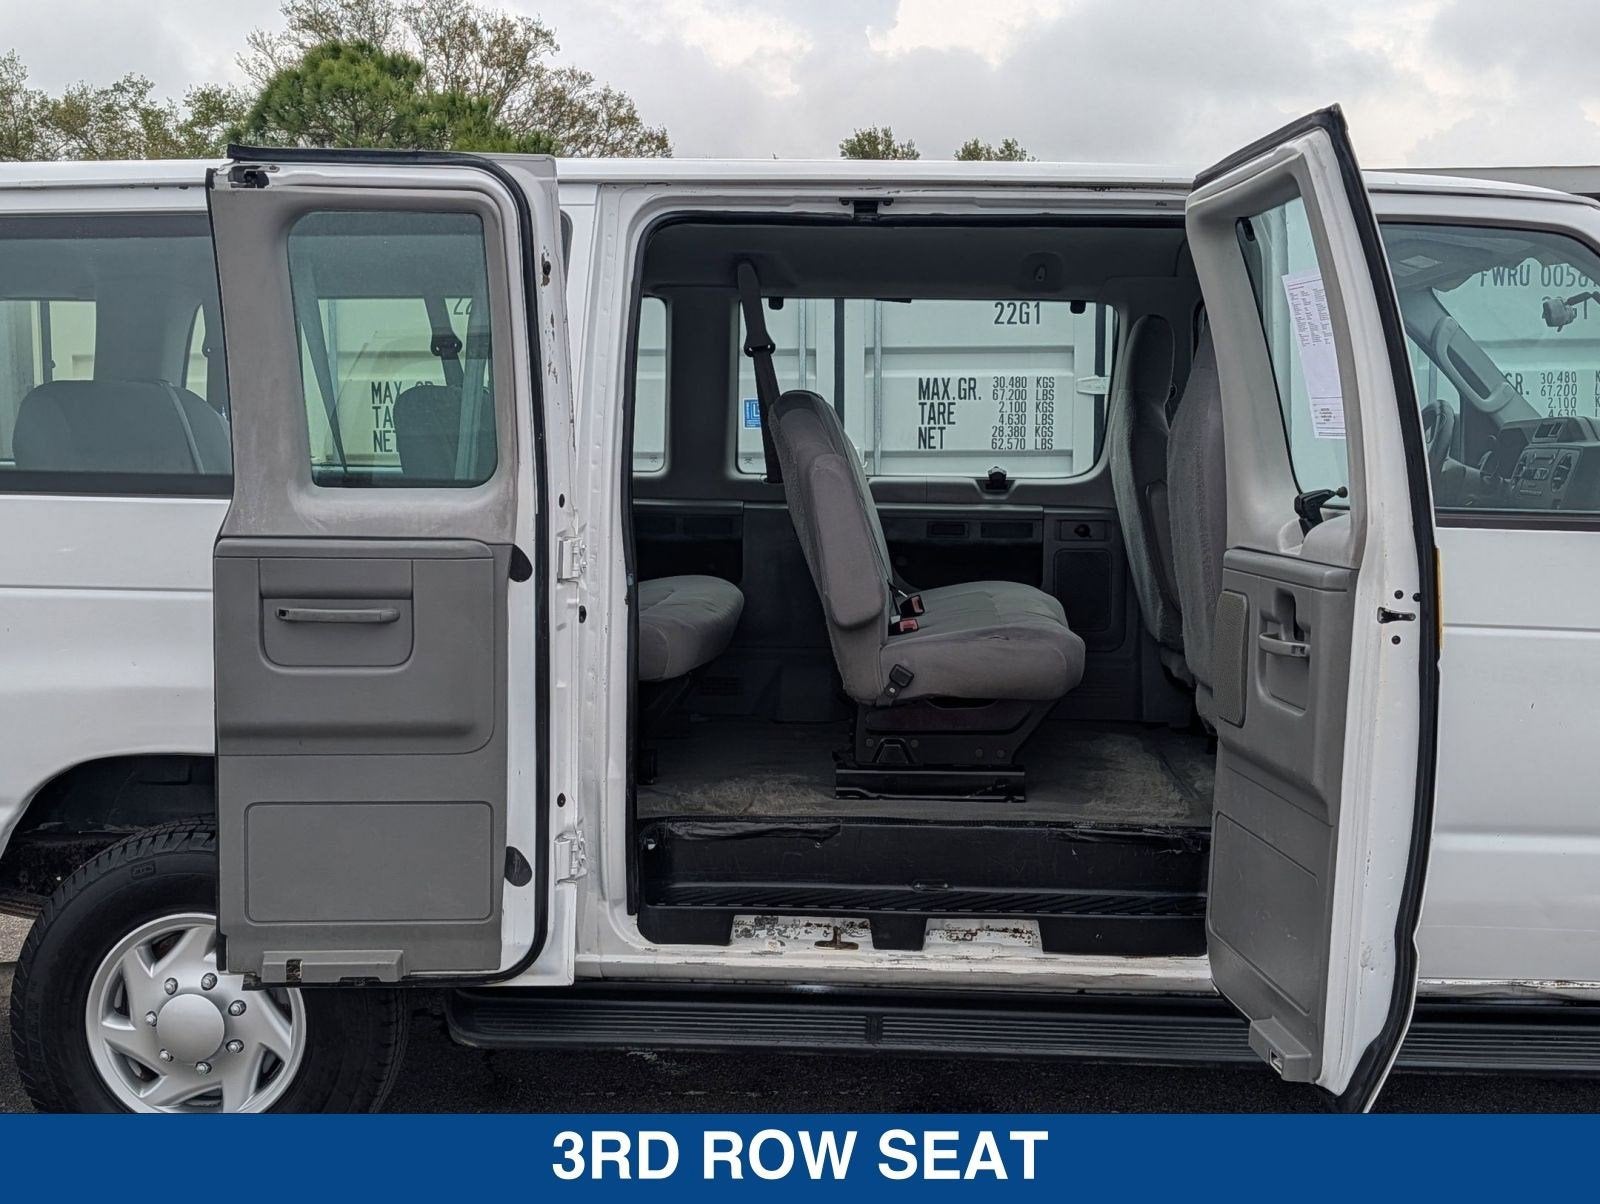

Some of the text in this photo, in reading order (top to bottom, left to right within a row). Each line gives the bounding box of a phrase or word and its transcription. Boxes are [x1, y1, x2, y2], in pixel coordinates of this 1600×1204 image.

[1480, 264, 1531, 287] FWRU
[994, 301, 1041, 325] 22G1
[992, 376, 1055, 389] 30.480 KGS
[992, 389, 1055, 401] 67.200 LBS
[998, 401, 1055, 413] 2.100 KGS
[1548, 397, 1577, 409] 2.100
[372, 406, 394, 429] TA
[918, 402, 957, 426] TARE
[998, 414, 1054, 426] 4.630 LBS
[917, 427, 947, 450] NET
[991, 426, 1054, 438] 28.380 KGS
[373, 430, 397, 453] NE
[991, 438, 1054, 451] 62.570 LBS
